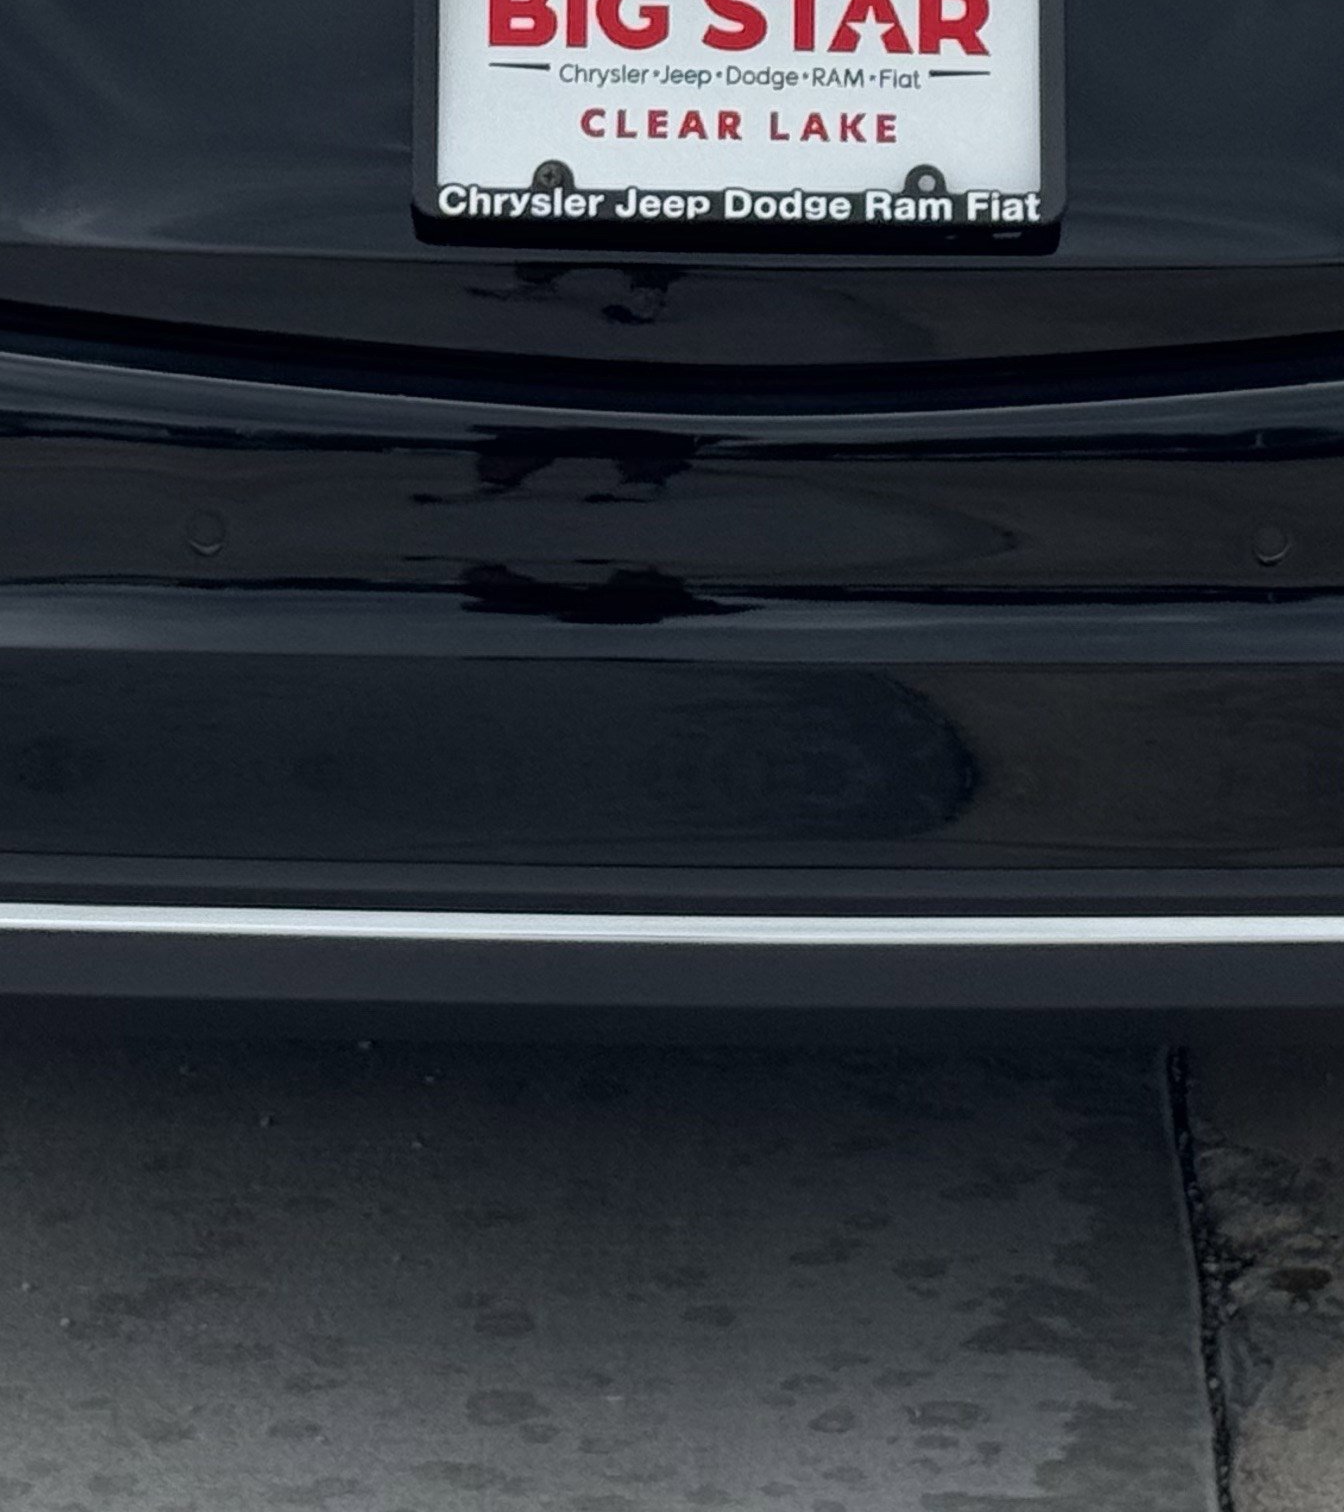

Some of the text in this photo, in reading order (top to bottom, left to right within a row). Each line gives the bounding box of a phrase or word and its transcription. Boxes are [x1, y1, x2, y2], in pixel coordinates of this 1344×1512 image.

[558, 63, 922, 91] Chrysler Jeep Dodge RAM Fiat
[579, 107, 899, 144] CLEAR LAKE
[437, 186, 1042, 224] Chrysler Jeep Dodge Ram Fiat
